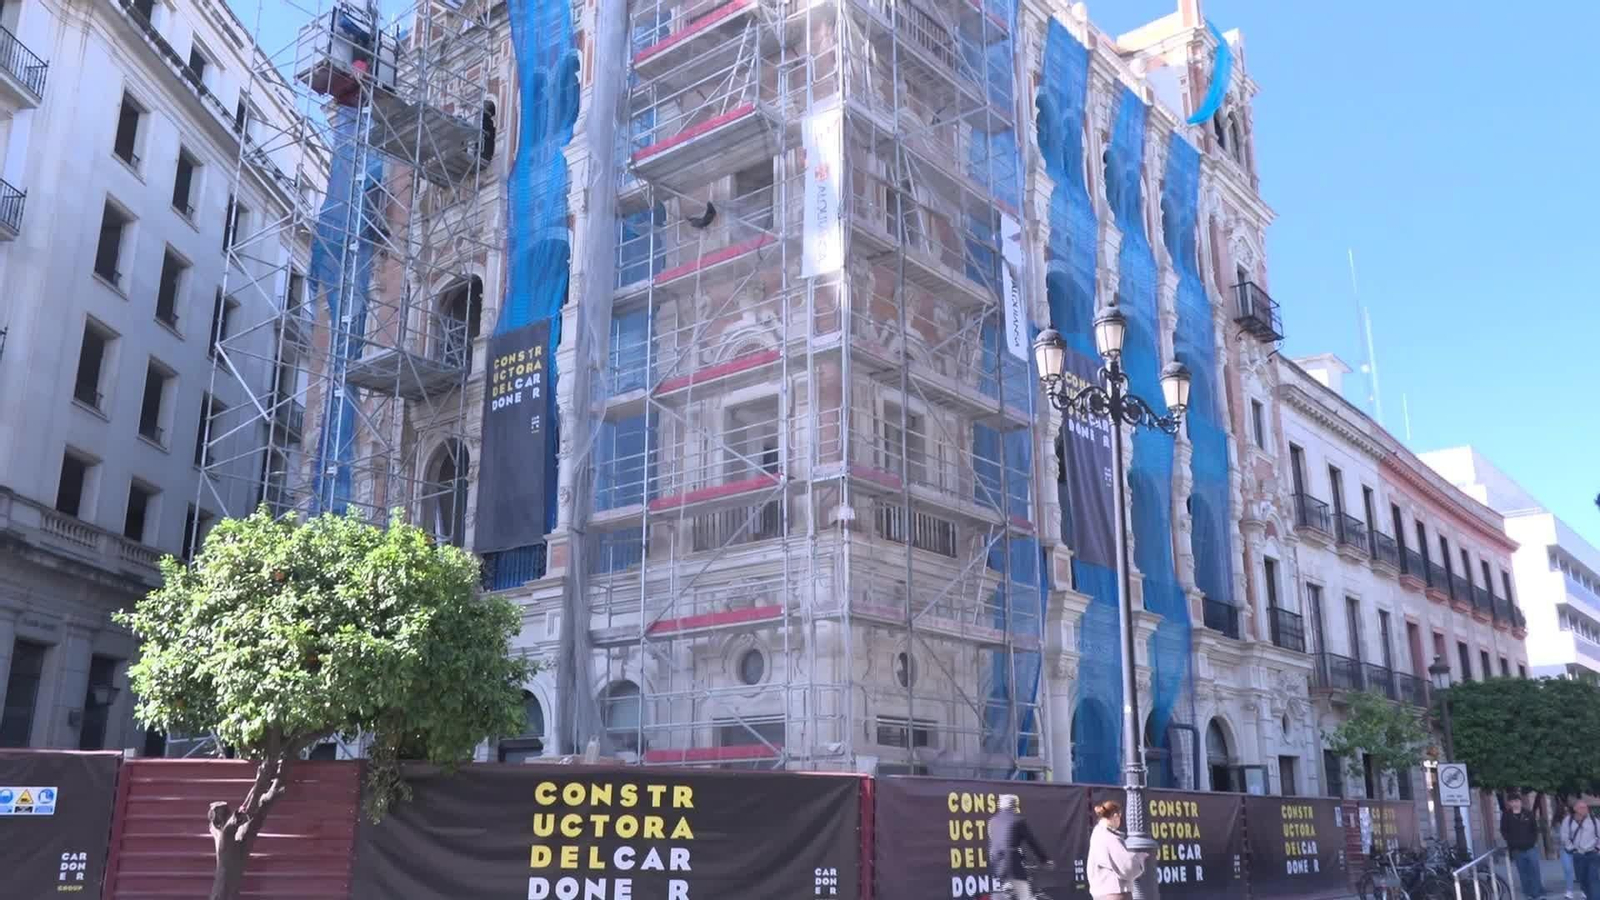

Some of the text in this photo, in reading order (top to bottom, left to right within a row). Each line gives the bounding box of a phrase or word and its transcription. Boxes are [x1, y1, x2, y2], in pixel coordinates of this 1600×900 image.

[493, 346, 542, 370] CONSTR
[493, 360, 542, 384] UCTORA
[534, 781, 694, 808] CONSTR
[1149, 800, 1198, 817] CONSTR
[533, 813, 694, 839] UCTORA
[1151, 822, 1200, 839] UCTORA
[61, 852, 87, 861] CAR
[815, 867, 837, 876] CAR
[815, 877, 837, 886] DON
[528, 876, 632, 900] DONE
